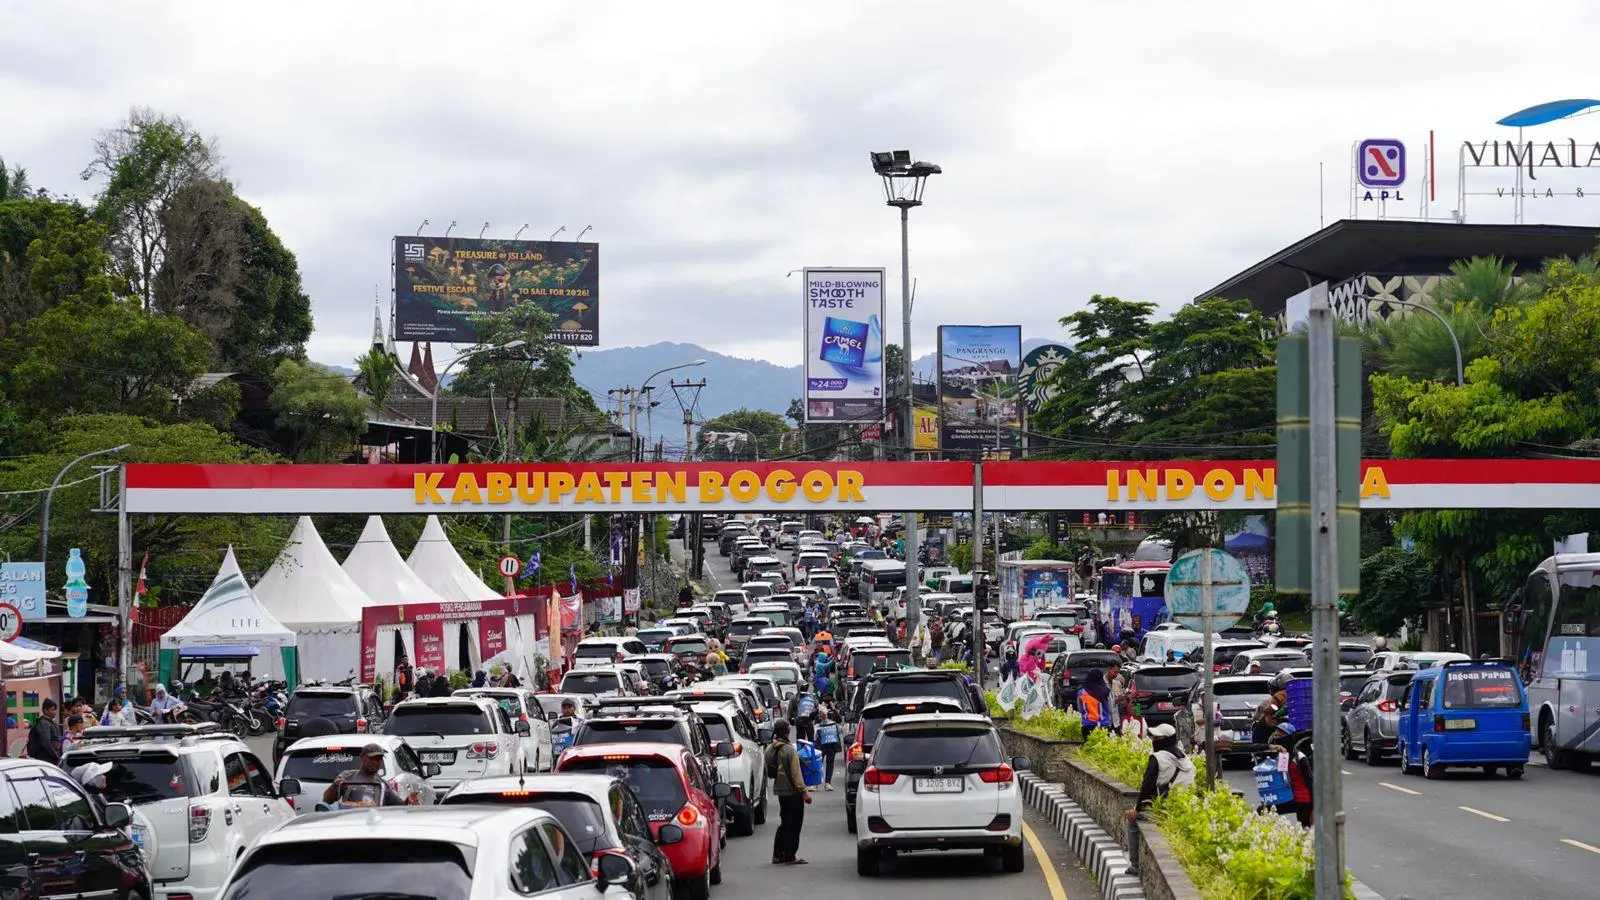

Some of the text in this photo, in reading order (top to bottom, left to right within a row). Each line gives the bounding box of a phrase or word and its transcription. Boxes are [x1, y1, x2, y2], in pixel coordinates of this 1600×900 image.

[1363, 190, 1403, 201] APL
[1497, 187, 1584, 198] VILLA &
[455, 250, 497, 260] TREASURE
[508, 252, 518, 261] JSI
[521, 252, 543, 261] LAND
[413, 285, 478, 293] FESTIVE ESCAPE
[519, 287, 589, 297] TO SAIL FOR 2026!
[810, 288, 864, 298] SMOOTH
[810, 298, 854, 308] TASTE
[580, 333, 593, 341] 820
[825, 336, 862, 350] CAMEL
[413, 468, 866, 506] KABUPATEN BOGOR
[1107, 466, 1392, 502] INDONA
[231, 618, 260, 628] LITE
[1448, 672, 1479, 682] Jagoan
[918, 778, 923, 788] B
